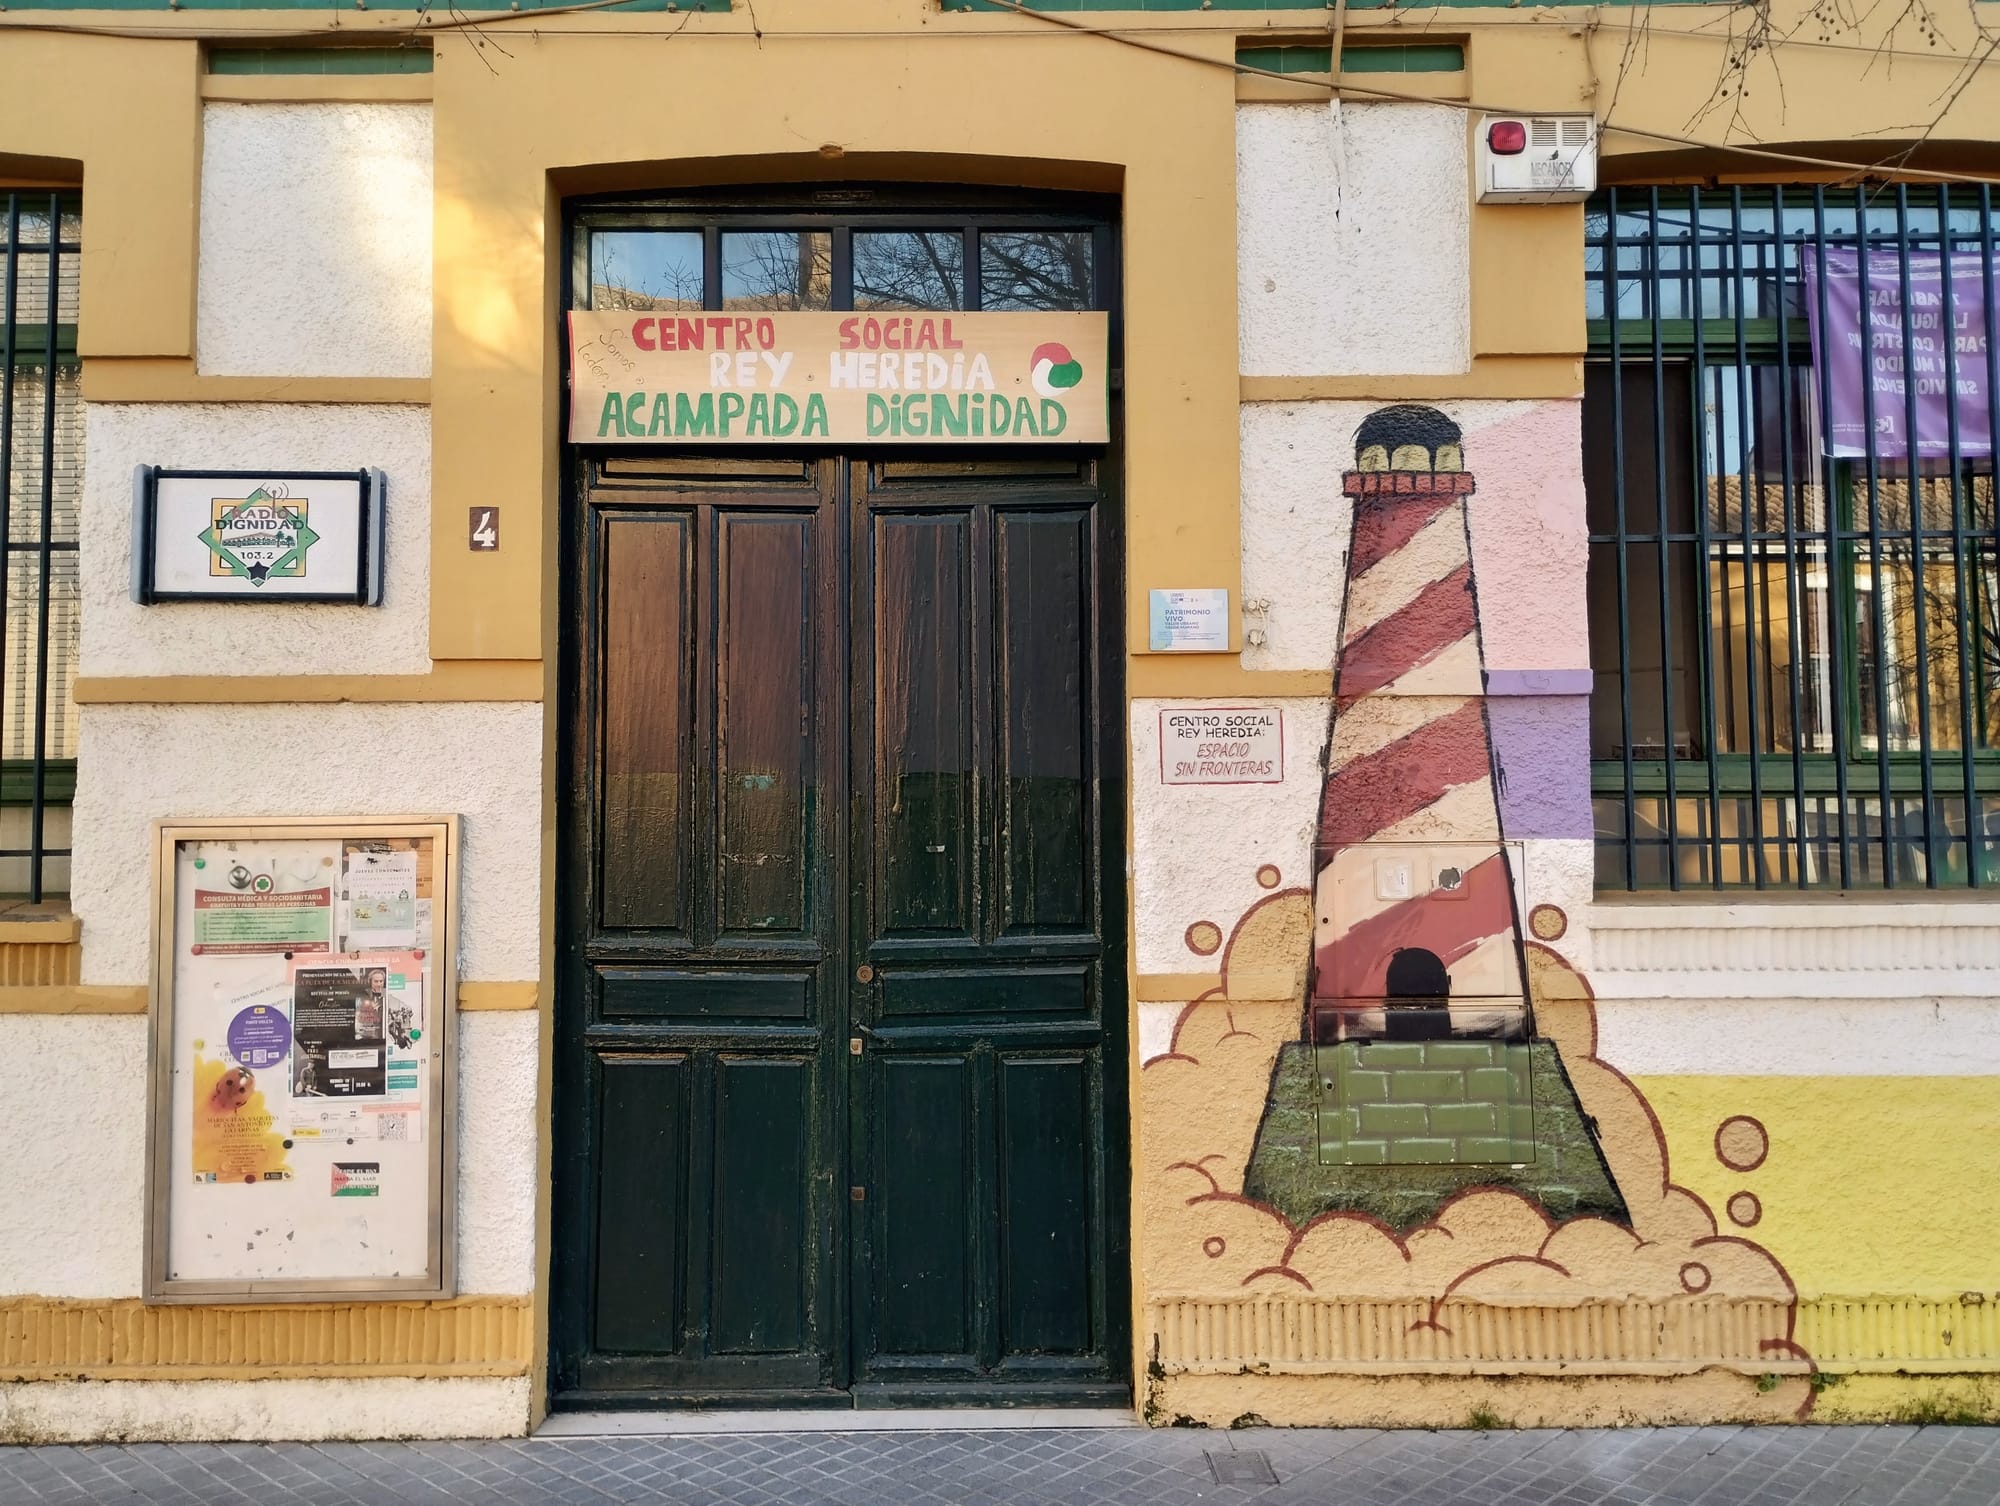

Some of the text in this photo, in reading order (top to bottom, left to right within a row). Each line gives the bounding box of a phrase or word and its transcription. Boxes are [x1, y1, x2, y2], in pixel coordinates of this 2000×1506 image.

[631, 317, 775, 351] CENTRO
[709, 350, 794, 389] REY
[597, 391, 830, 437] ACAMPADA
[231, 508, 290, 520] RADIO
[214, 518, 305, 531] DIGNIDAD
[473, 511, 496, 547] 4
[241, 551, 274, 561] 103.2
[1169, 715, 1274, 727] CENTRO SOCIAL
[1177, 727, 1266, 739] REY HEREDIA:
[1197, 742, 1250, 758] ESPACIO
[1175, 760, 1273, 777] SIN FRONTERAS
